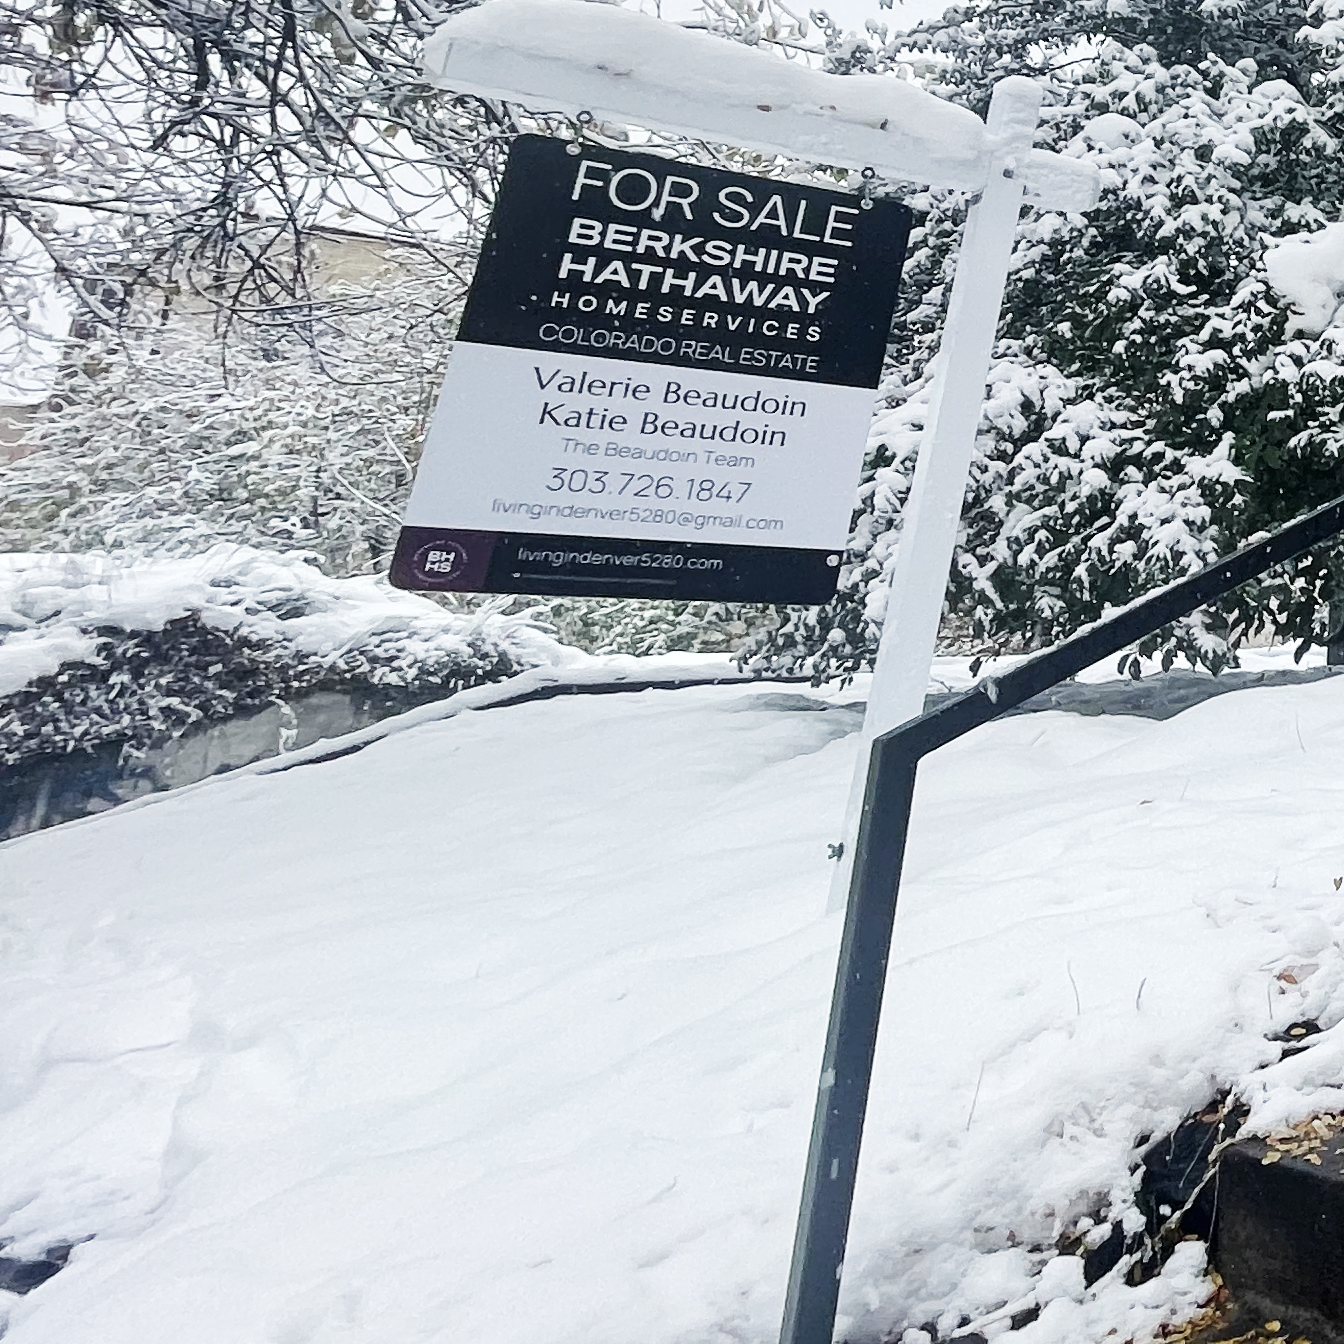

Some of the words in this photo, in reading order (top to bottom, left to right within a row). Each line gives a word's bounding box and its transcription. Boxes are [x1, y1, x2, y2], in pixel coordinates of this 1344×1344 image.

[571, 160, 700, 220] FOR
[712, 185, 860, 247] SALE
[568, 217, 839, 283] BERKSHIRE
[558, 253, 832, 314] HATHAWAY
[550, 291, 822, 342] HOMESERVICES
[538, 323, 676, 357] COLORADO
[680, 340, 736, 363] REAL
[739, 346, 820, 373] ESTATE
[533, 366, 651, 401] Valerie
[663, 382, 808, 419] Beaudoin
[538, 402, 628, 433] Katie
[639, 411, 788, 448] Beaudoin
[561, 437, 600, 456] The
[604, 441, 698, 464] Beaudoin
[704, 450, 755, 468] Team
[545, 467, 752, 504] 303.726.1847
[491, 498, 784, 530] livingindenver5280@gmail.com
[517, 547, 723, 571] livingindenver5280.com
